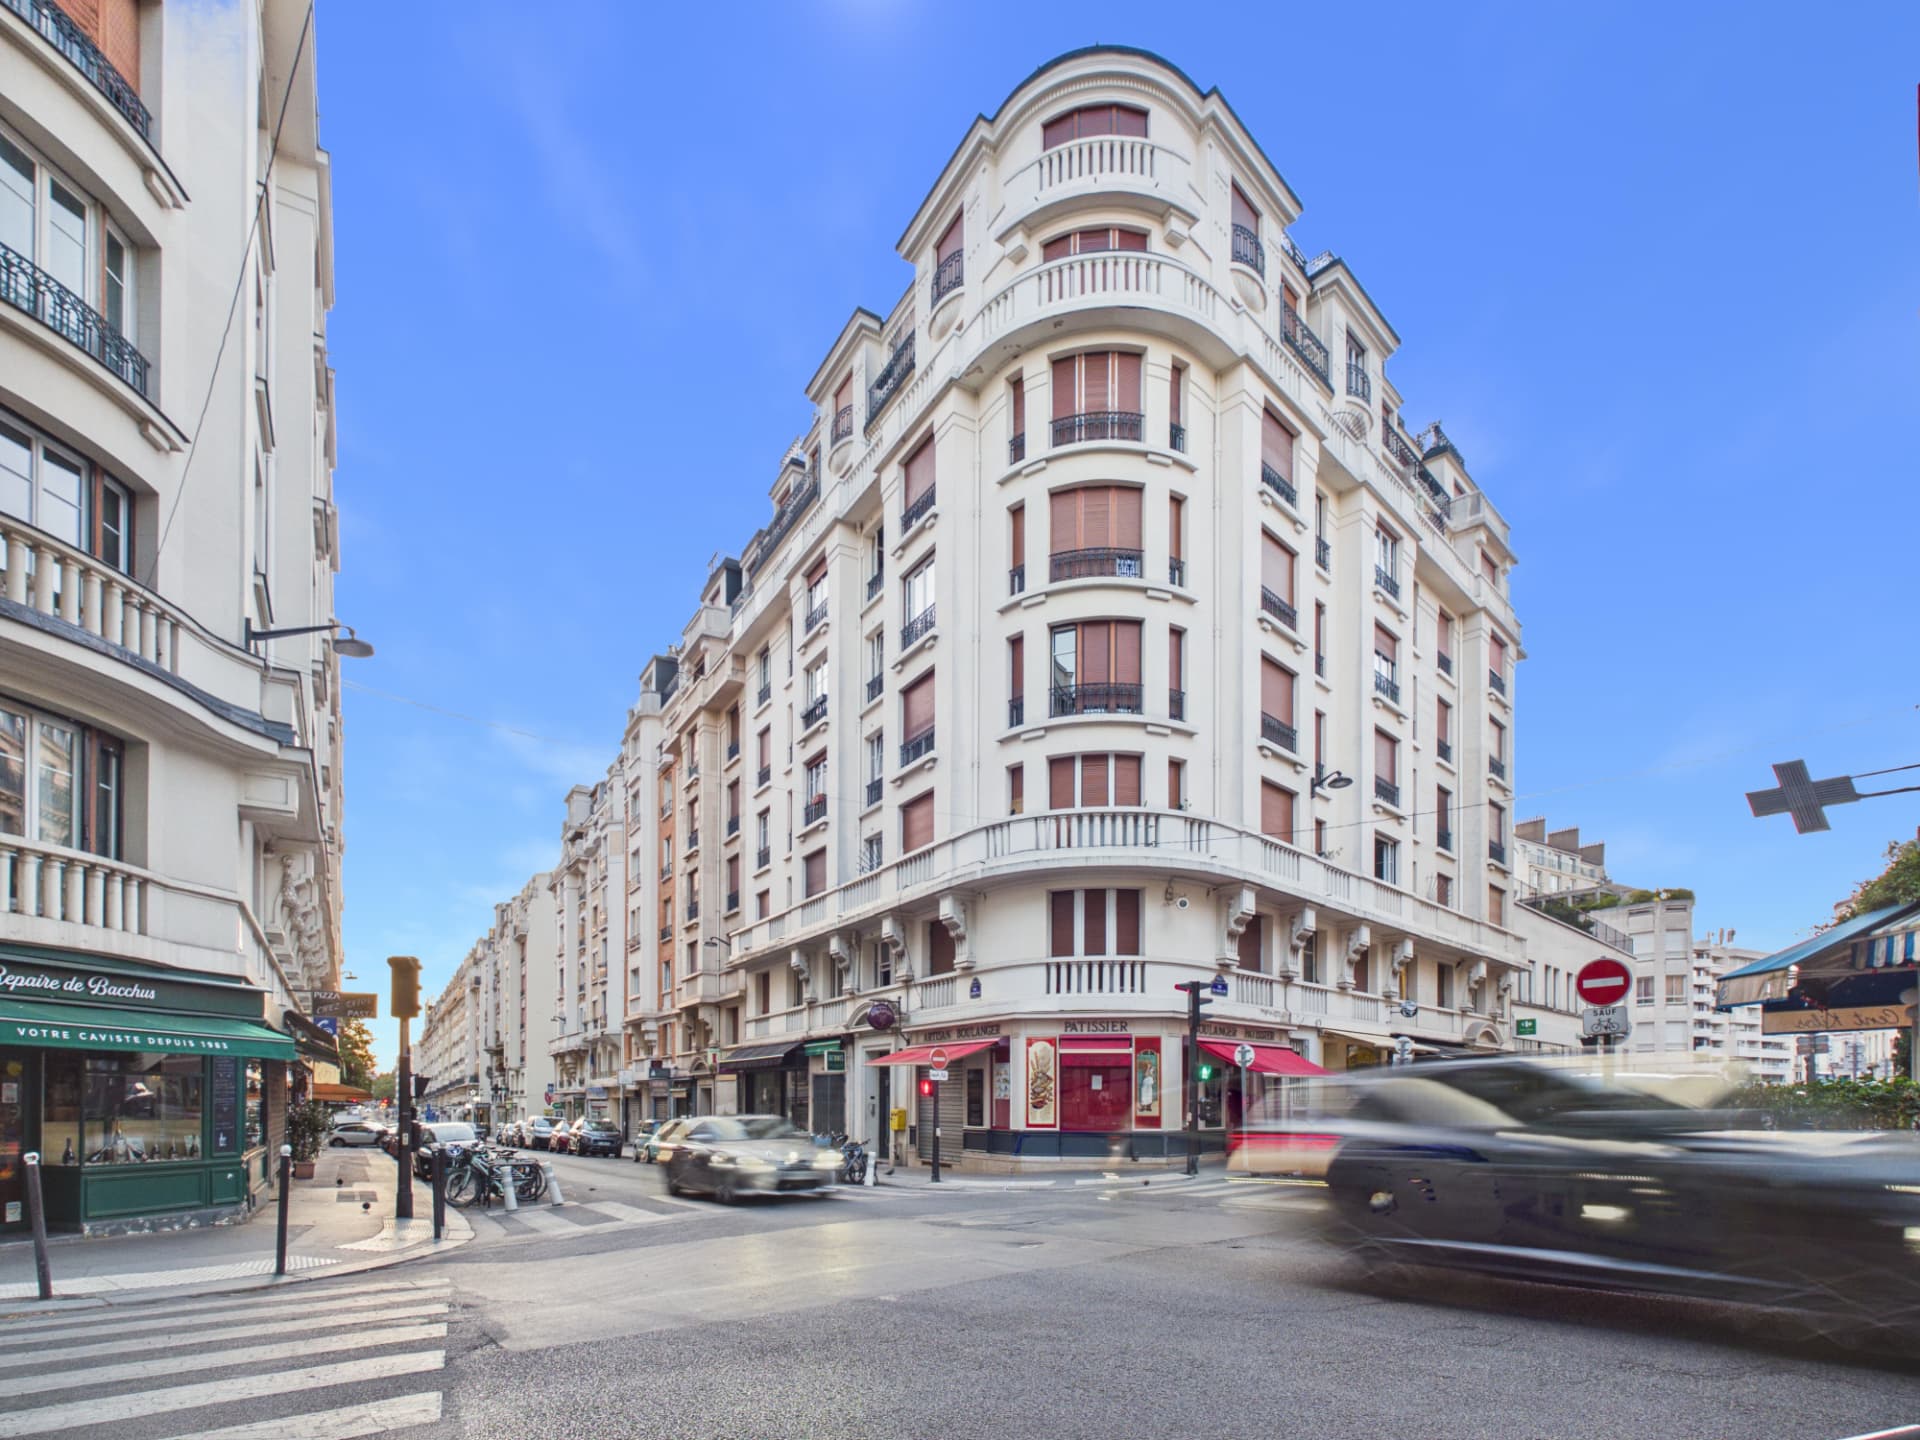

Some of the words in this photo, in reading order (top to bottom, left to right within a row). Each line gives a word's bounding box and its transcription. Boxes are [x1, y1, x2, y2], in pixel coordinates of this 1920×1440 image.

[62, 976, 85, 992] de
[88, 975, 156, 1000] Bacchus
[314, 991, 340, 999] PIZZA
[1593, 1008, 1617, 1017] SAUF
[17, 1027, 70, 1040] VOTRE
[78, 1031, 141, 1044] CAVISTE
[147, 1037, 195, 1047] DEPUIS
[956, 1024, 1001, 1039] BOULANGER
[1197, 1022, 1238, 1038] OULANGER
